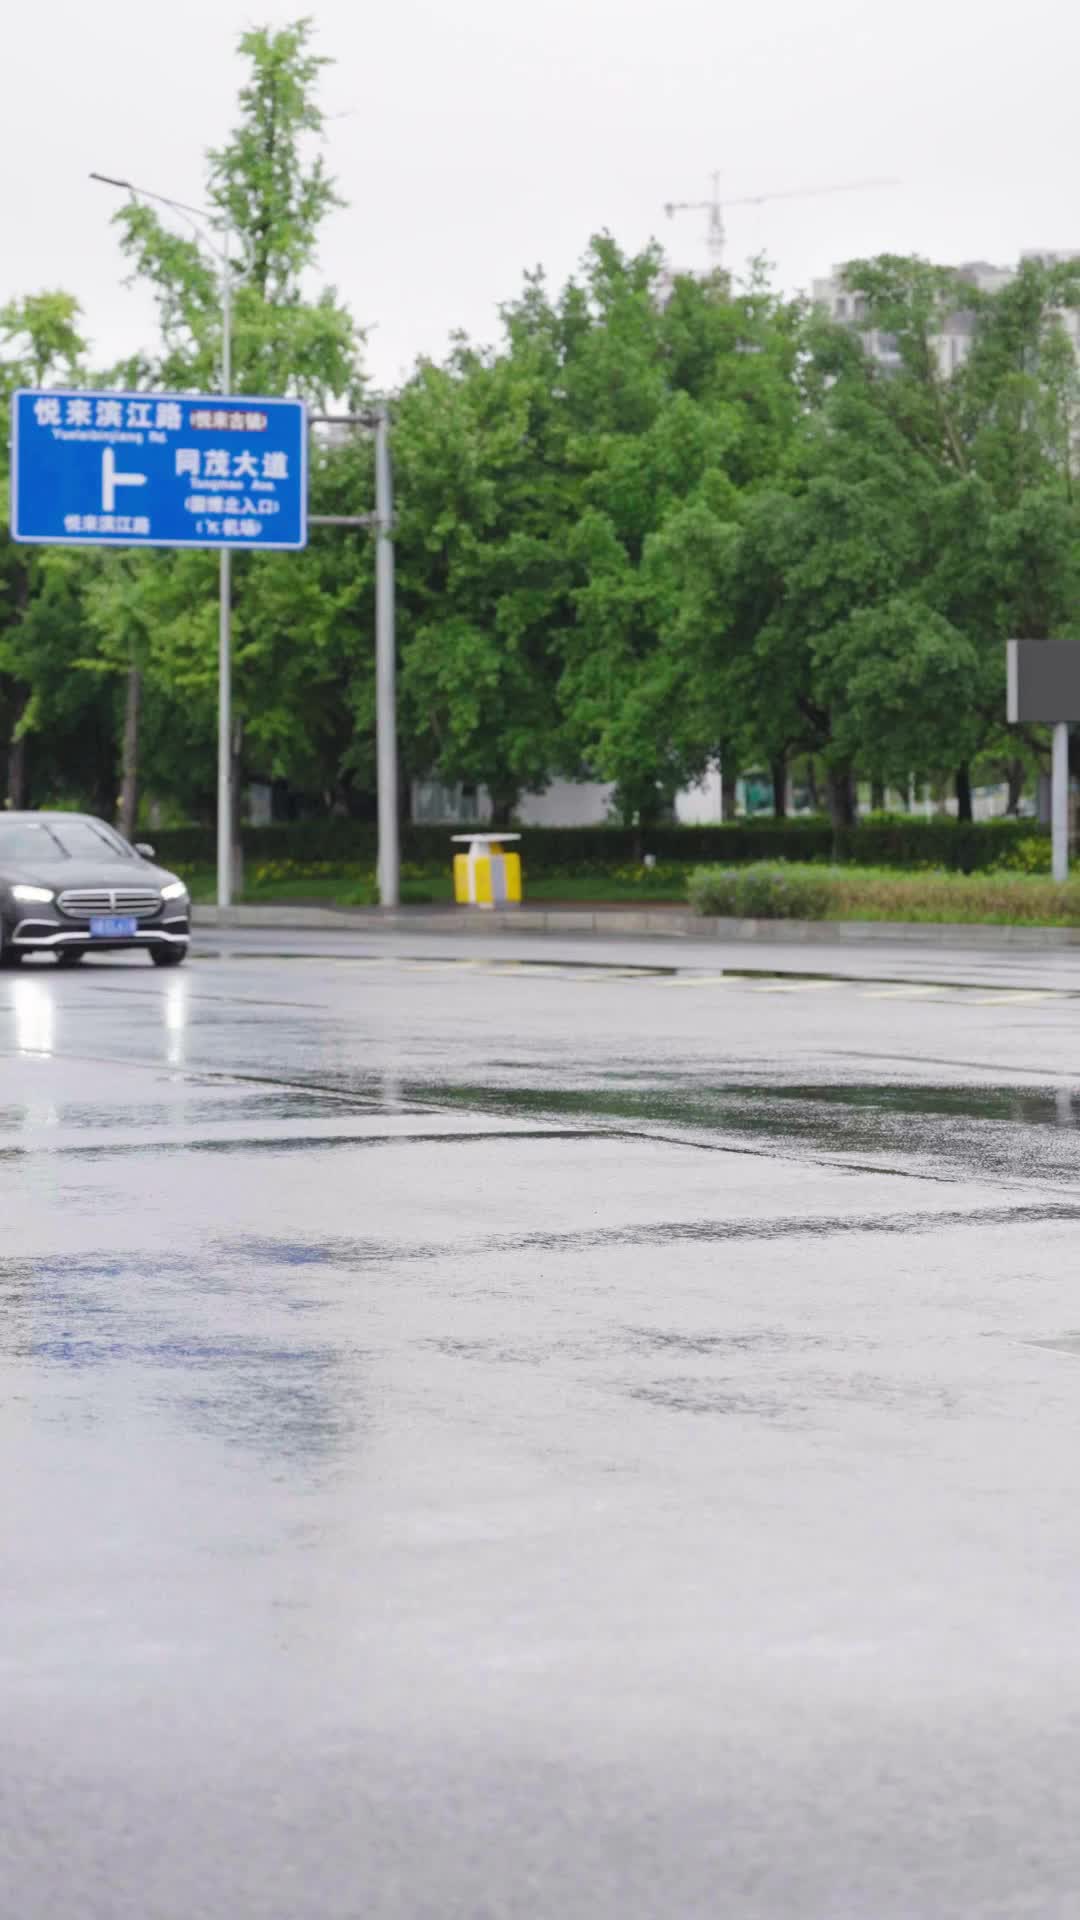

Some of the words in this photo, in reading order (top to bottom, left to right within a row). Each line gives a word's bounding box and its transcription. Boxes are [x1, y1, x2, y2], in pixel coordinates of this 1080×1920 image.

[34, 397, 182, 430] 悦来滨江路
[175, 449, 289, 479] 同茂大道
